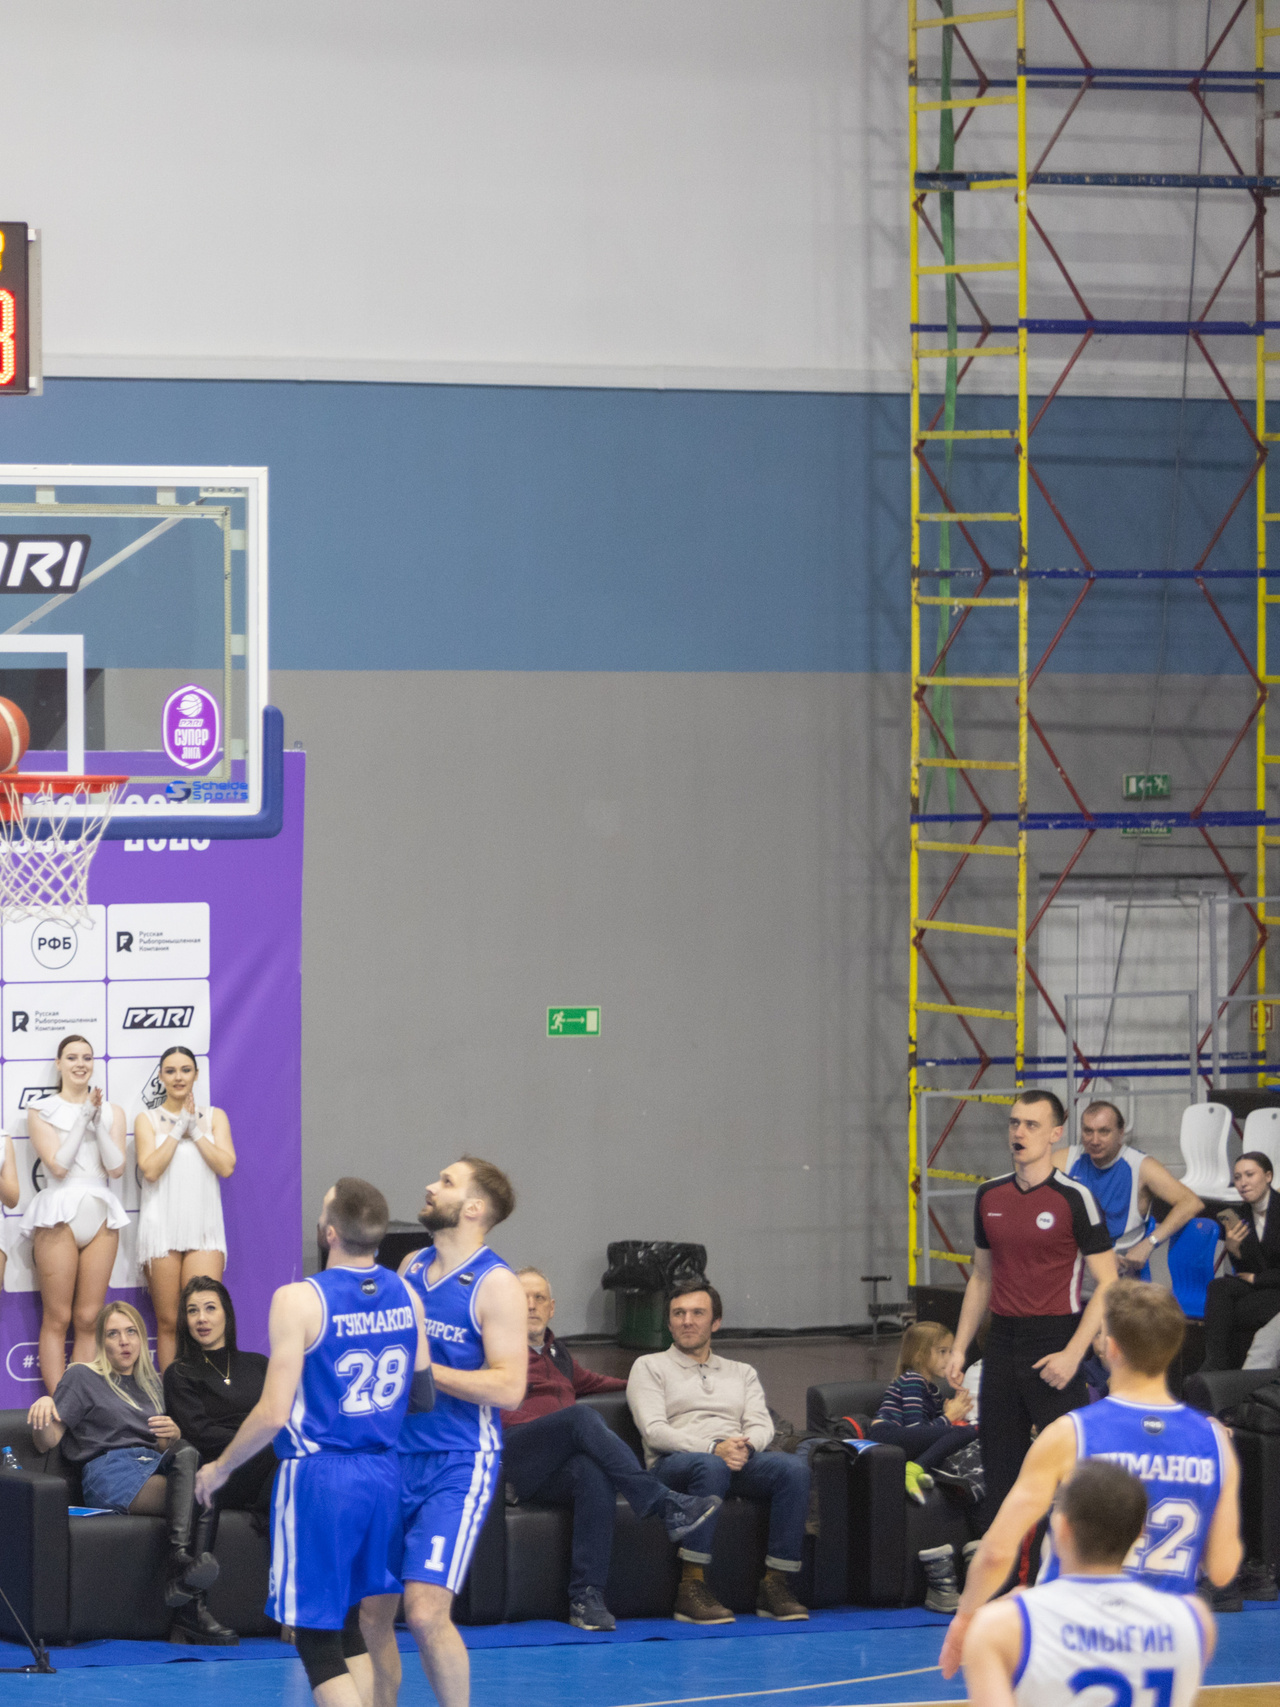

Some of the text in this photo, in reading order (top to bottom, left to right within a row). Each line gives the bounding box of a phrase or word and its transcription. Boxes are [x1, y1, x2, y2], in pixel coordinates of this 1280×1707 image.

[192, 781, 248, 790] Schelde
[192, 791, 248, 802] Sports
[37, 937, 72, 950] РФБ
[139, 937, 201, 945] Рыбопромышленная
[123, 1007, 194, 1028] PARI
[332, 1306, 414, 1337] ТУКМАКОВ
[334, 1344, 409, 1417] 28
[424, 1535, 446, 1572] 1
[1061, 1623, 1176, 1653] СМЫГИН
